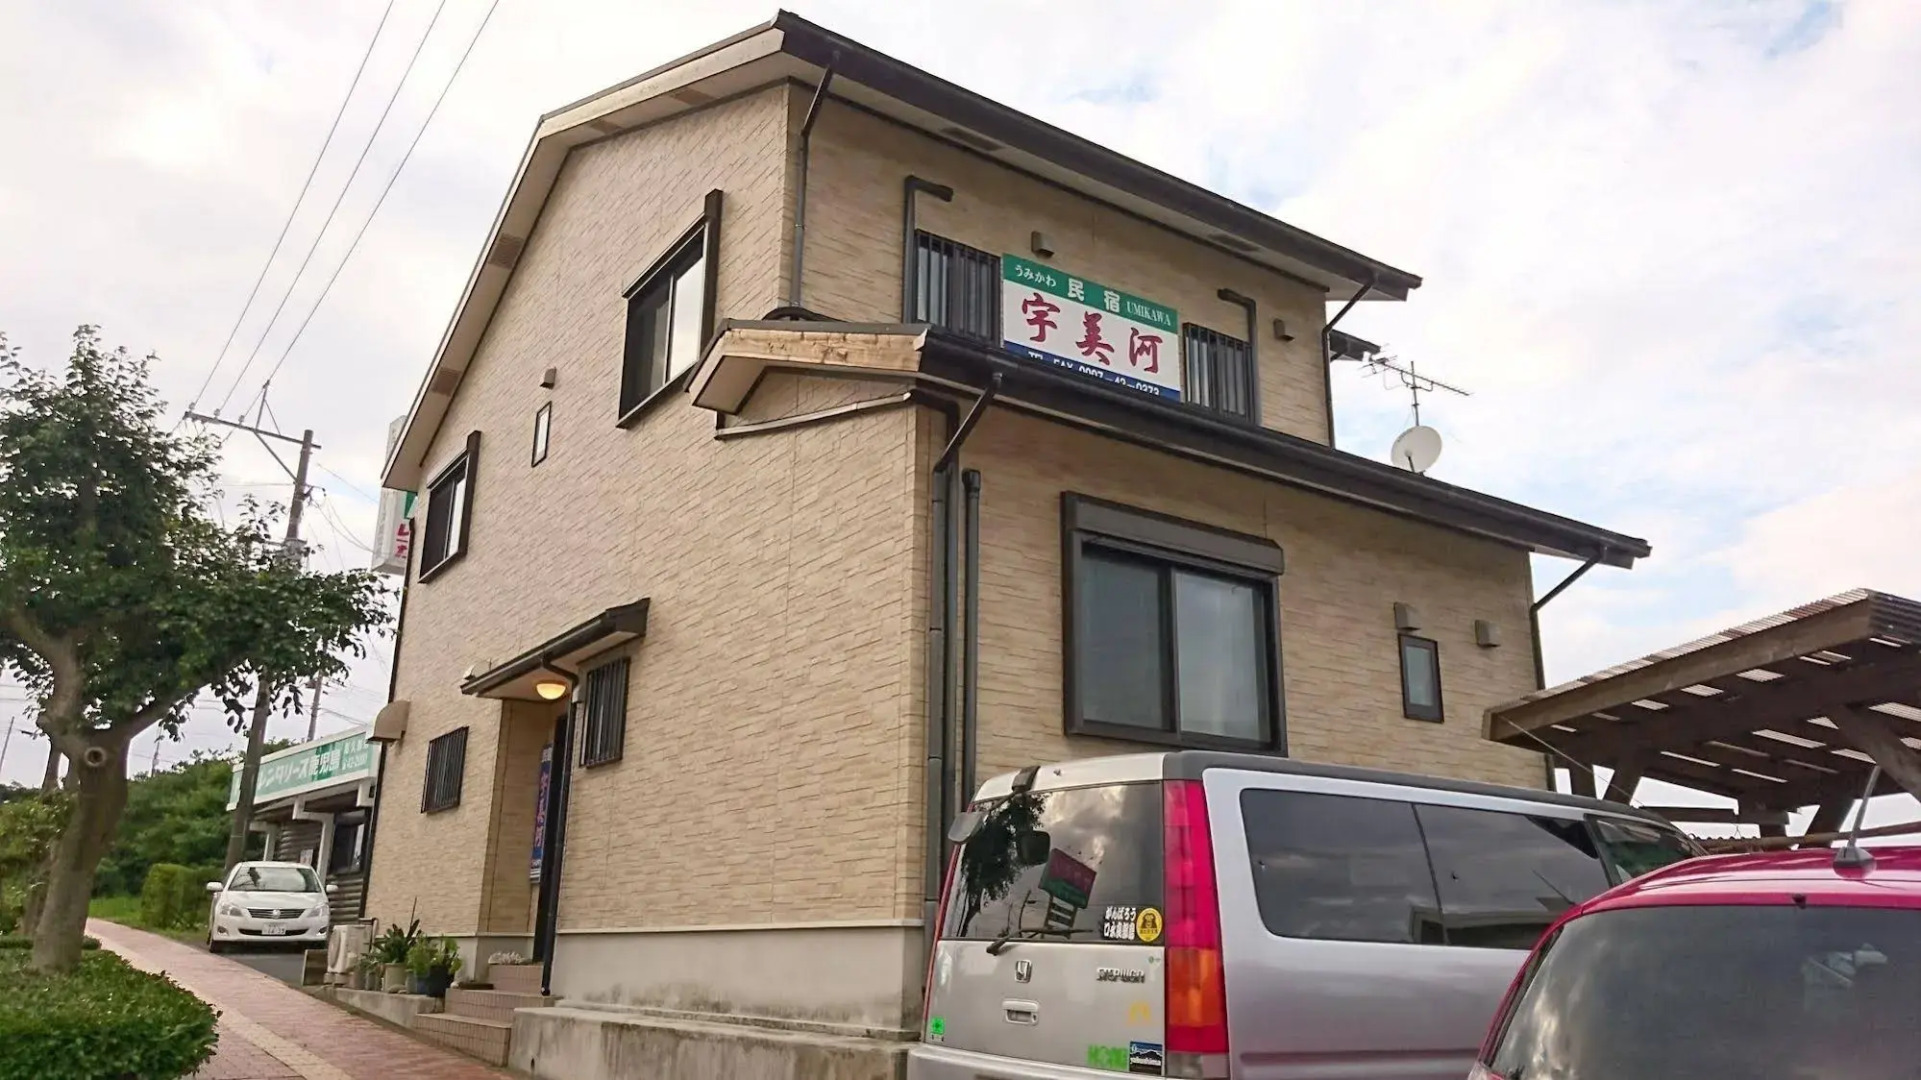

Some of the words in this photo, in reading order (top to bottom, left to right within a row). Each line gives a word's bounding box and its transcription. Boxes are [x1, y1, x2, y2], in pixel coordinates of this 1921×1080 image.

[1014, 264, 1057, 288] うみかわ
[1067, 278, 1120, 313] 民宿
[1126, 301, 1172, 327] UMIKAWA
[1021, 292, 1163, 375] 宇美河
